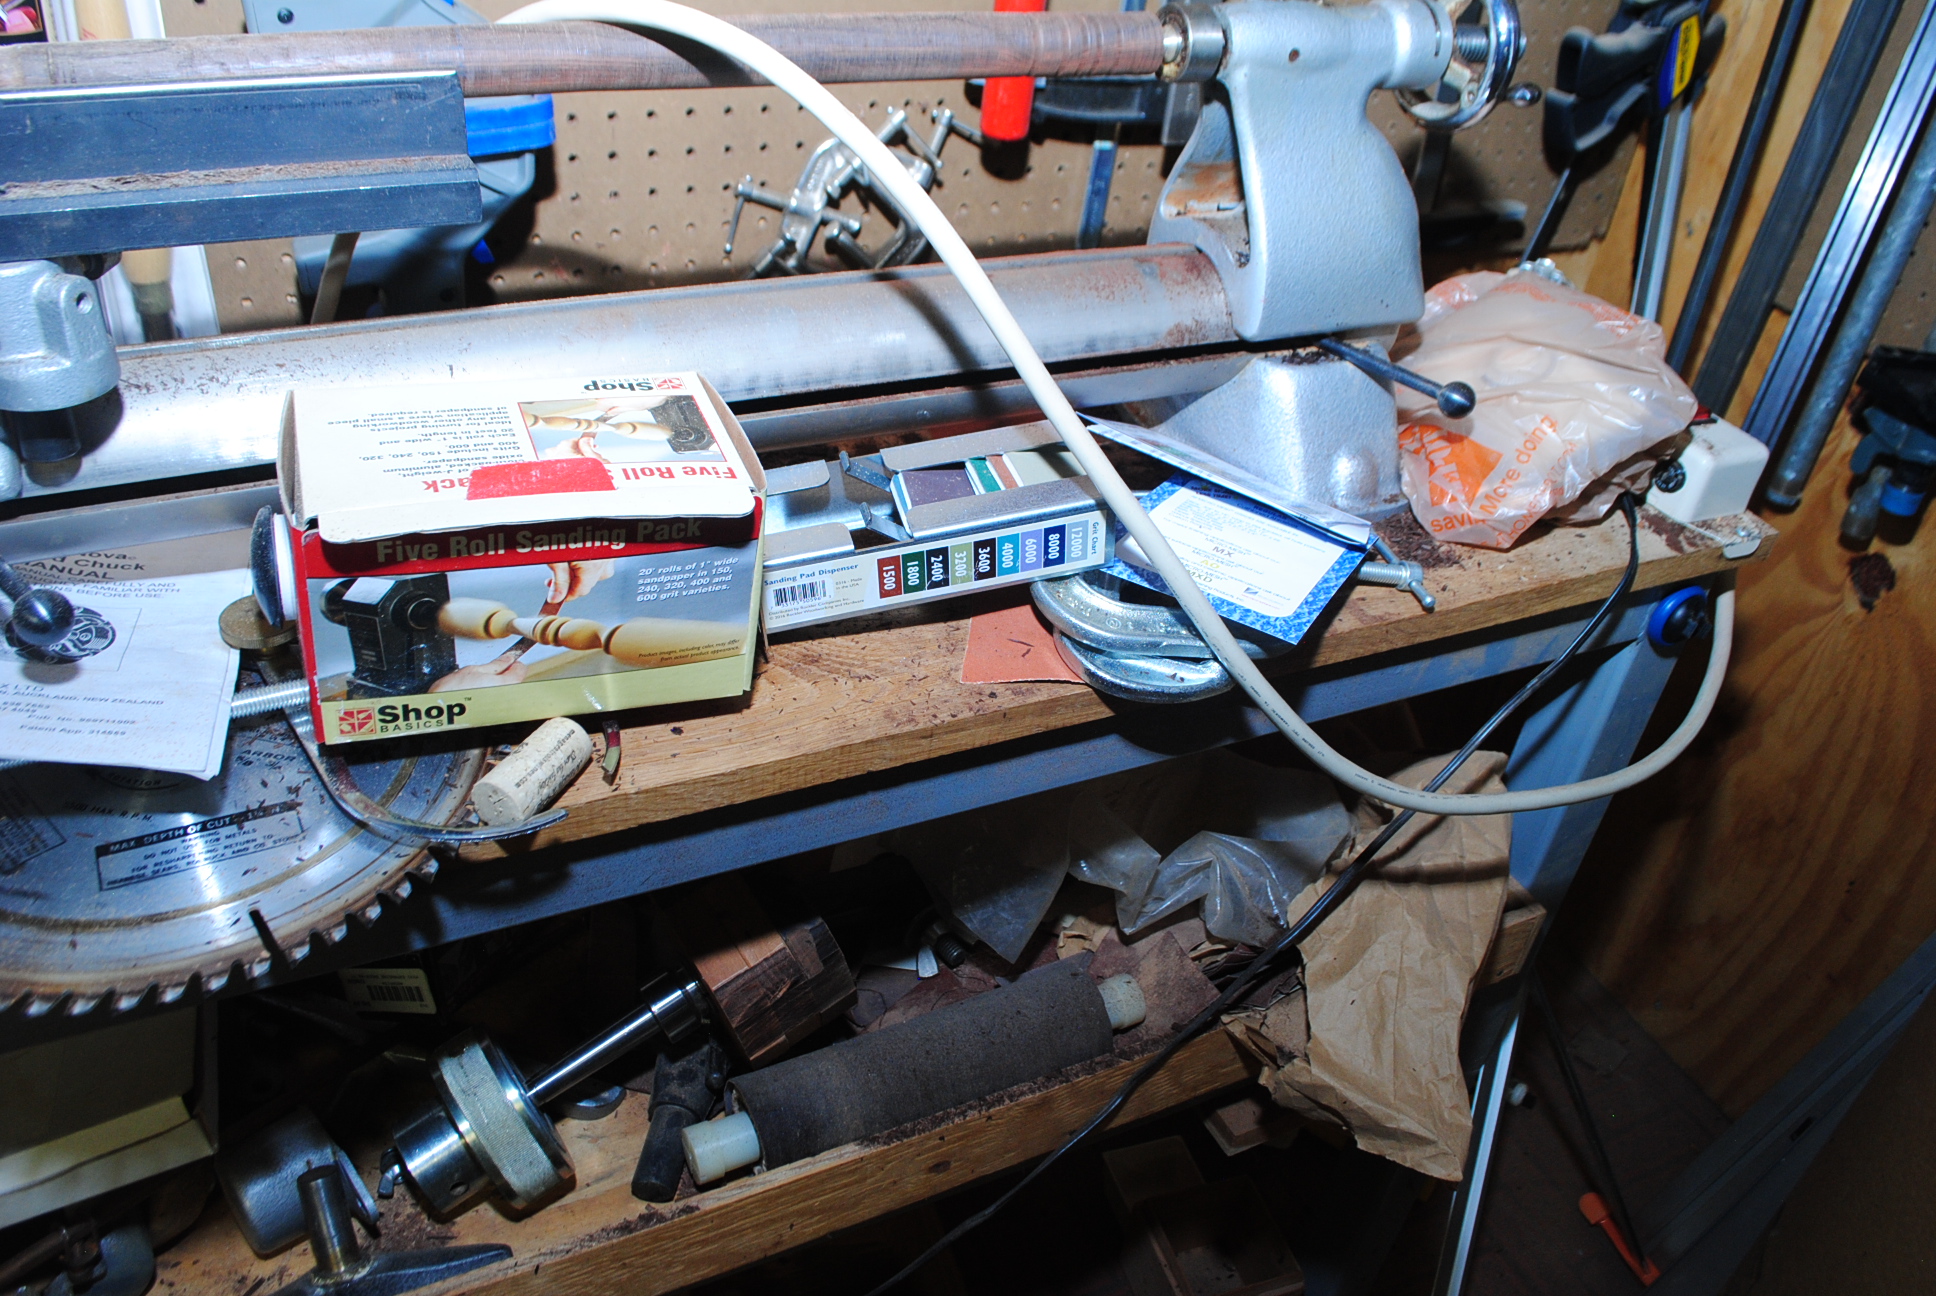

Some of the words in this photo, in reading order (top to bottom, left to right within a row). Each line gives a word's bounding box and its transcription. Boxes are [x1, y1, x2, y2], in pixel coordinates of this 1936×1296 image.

[584, 379, 655, 392] Shop
[621, 466, 675, 481] Roll
[683, 465, 737, 480] Five
[422, 477, 469, 493] ack
[1480, 467, 1522, 515] More
[1092, 521, 1100, 535] Grit
[376, 538, 439, 563] Five
[449, 532, 505, 558] Roll
[515, 525, 626, 553] Sanding
[637, 518, 702, 541] Pack
[1025, 538, 1038, 565] 6000
[1048, 533, 1061, 560] 8000
[1071, 526, 1083, 558] 12000
[1212, 545, 1234, 558] MX
[74, 558, 147, 572] Chuck
[658, 565, 682, 575] rolls
[685, 561, 697, 571] of
[714, 556, 739, 567] wide
[954, 550, 968, 578] 3200
[979, 546, 991, 574] 3600
[1002, 542, 1015, 569] 4000
[1200, 558, 1219, 569] AO
[637, 570, 695, 585] sandpaper
[698, 568, 708, 577] in
[711, 566, 733, 577] 150,
[764, 575, 798, 587] Sanding
[799, 570, 816, 580] Pad
[818, 563, 859, 576] Dispenser
[883, 565, 896, 591] 1500
[907, 561, 920, 587] 1800
[931, 554, 945, 583] 2400
[1186, 569, 1212, 583] MXD
[637, 583, 660, 594] 240,
[664, 580, 686, 591] 320,
[689, 577, 710, 587] 400
[713, 573, 733, 583] and
[637, 592, 657, 602] 600
[660, 590, 679, 601] grit
[377, 697, 466, 726] Shop
[379, 719, 445, 734] BASICS
[143, 827, 184, 845] DEPTH
[206, 816, 230, 829] CUT
